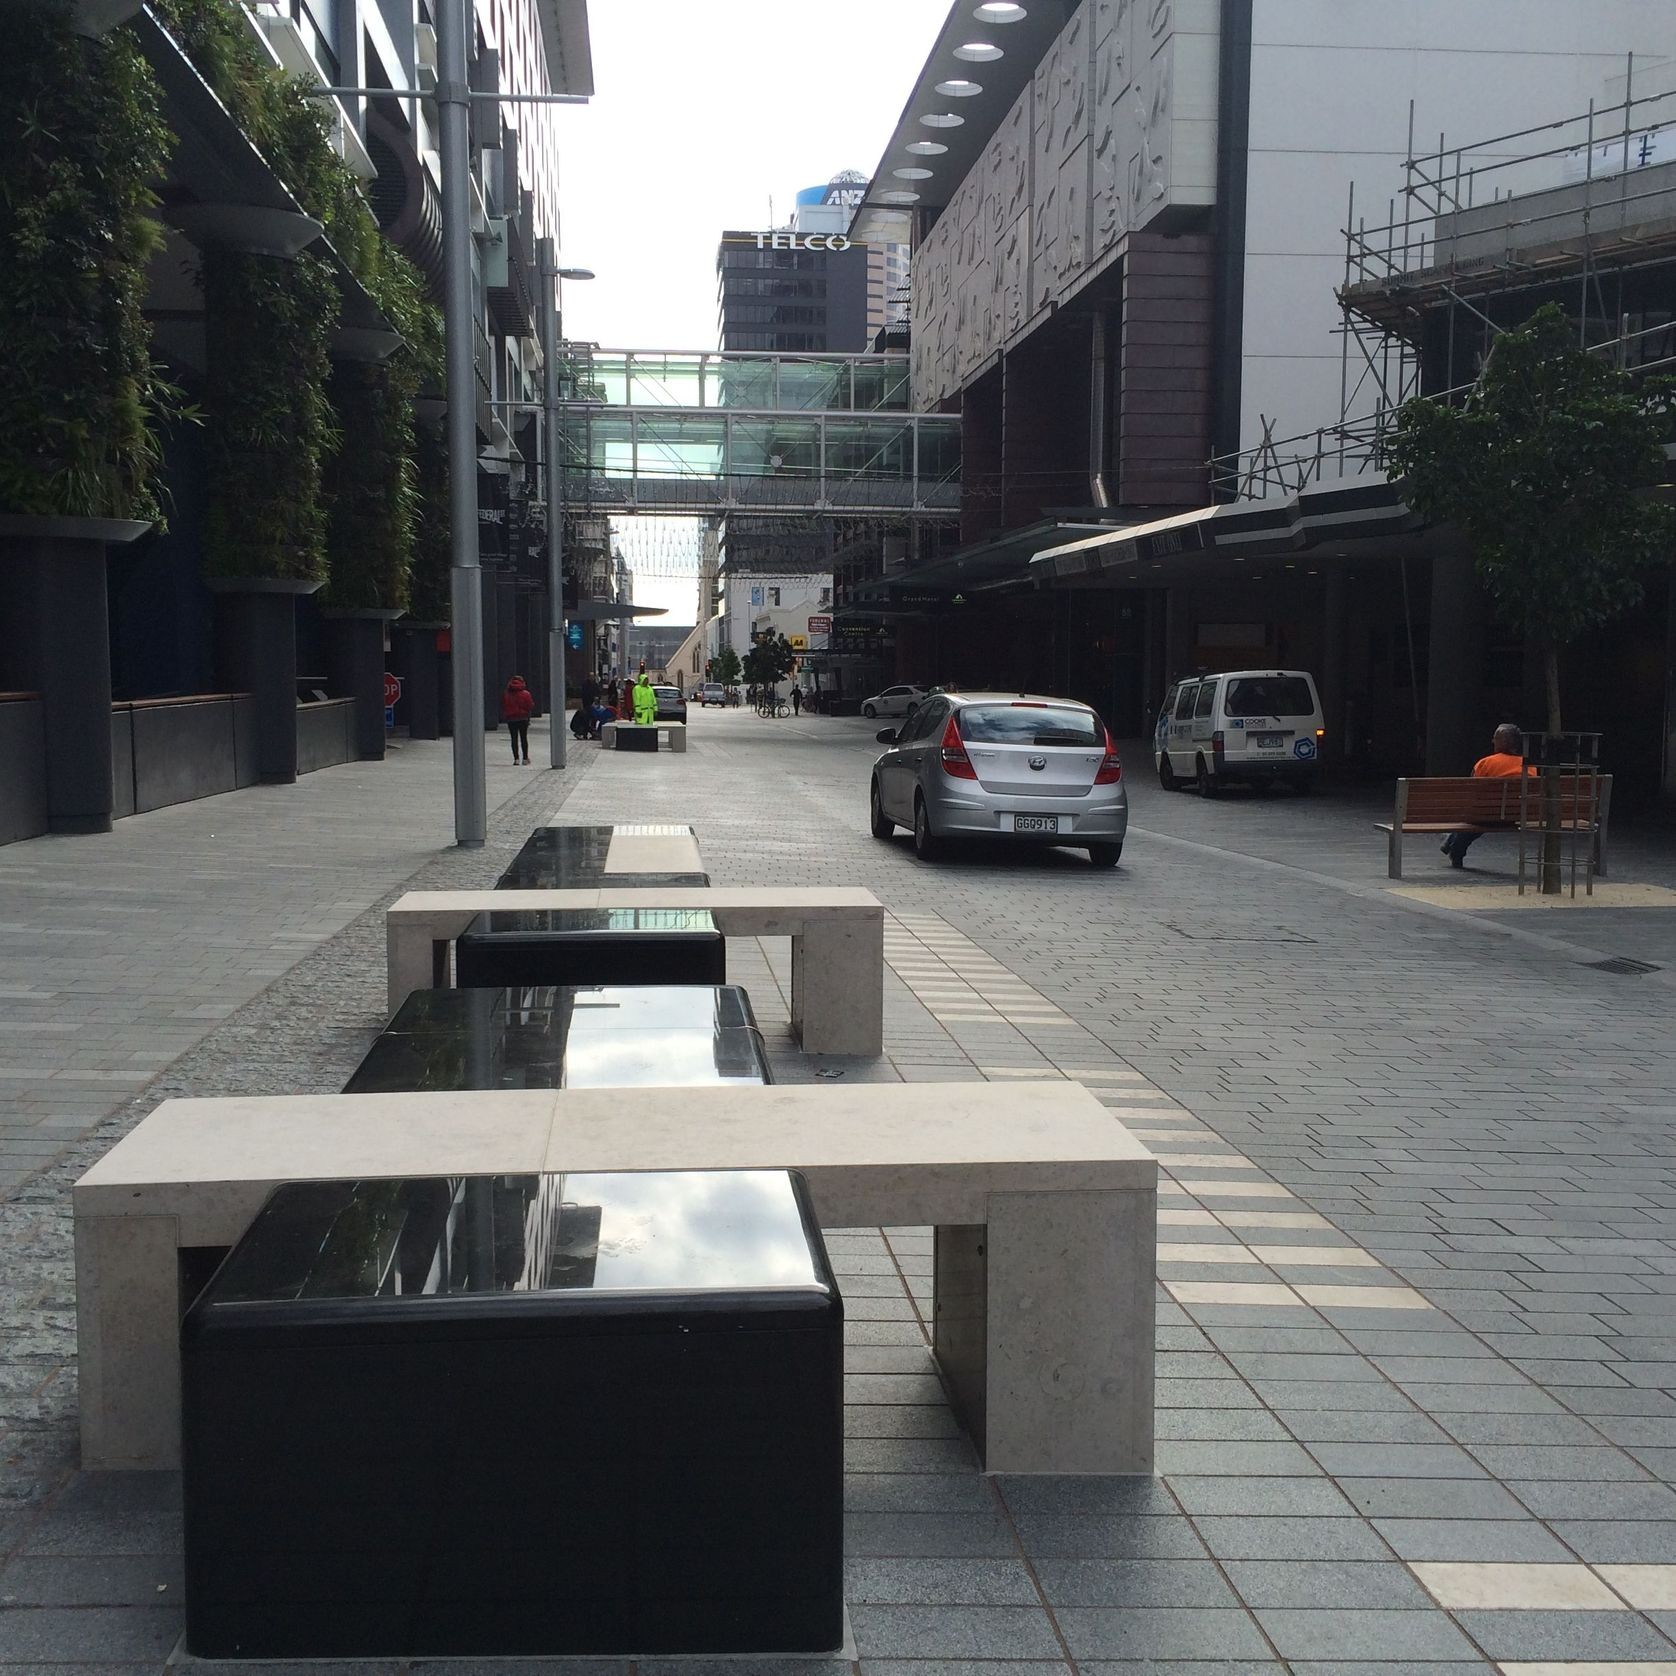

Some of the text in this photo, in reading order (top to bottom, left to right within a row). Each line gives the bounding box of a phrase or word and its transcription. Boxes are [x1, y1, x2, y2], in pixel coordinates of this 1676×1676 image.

[826, 189, 866, 206] ANZ
[750, 232, 851, 251] TELCO
[793, 639, 804, 647] AA
[1016, 817, 1057, 830] GGQ913
